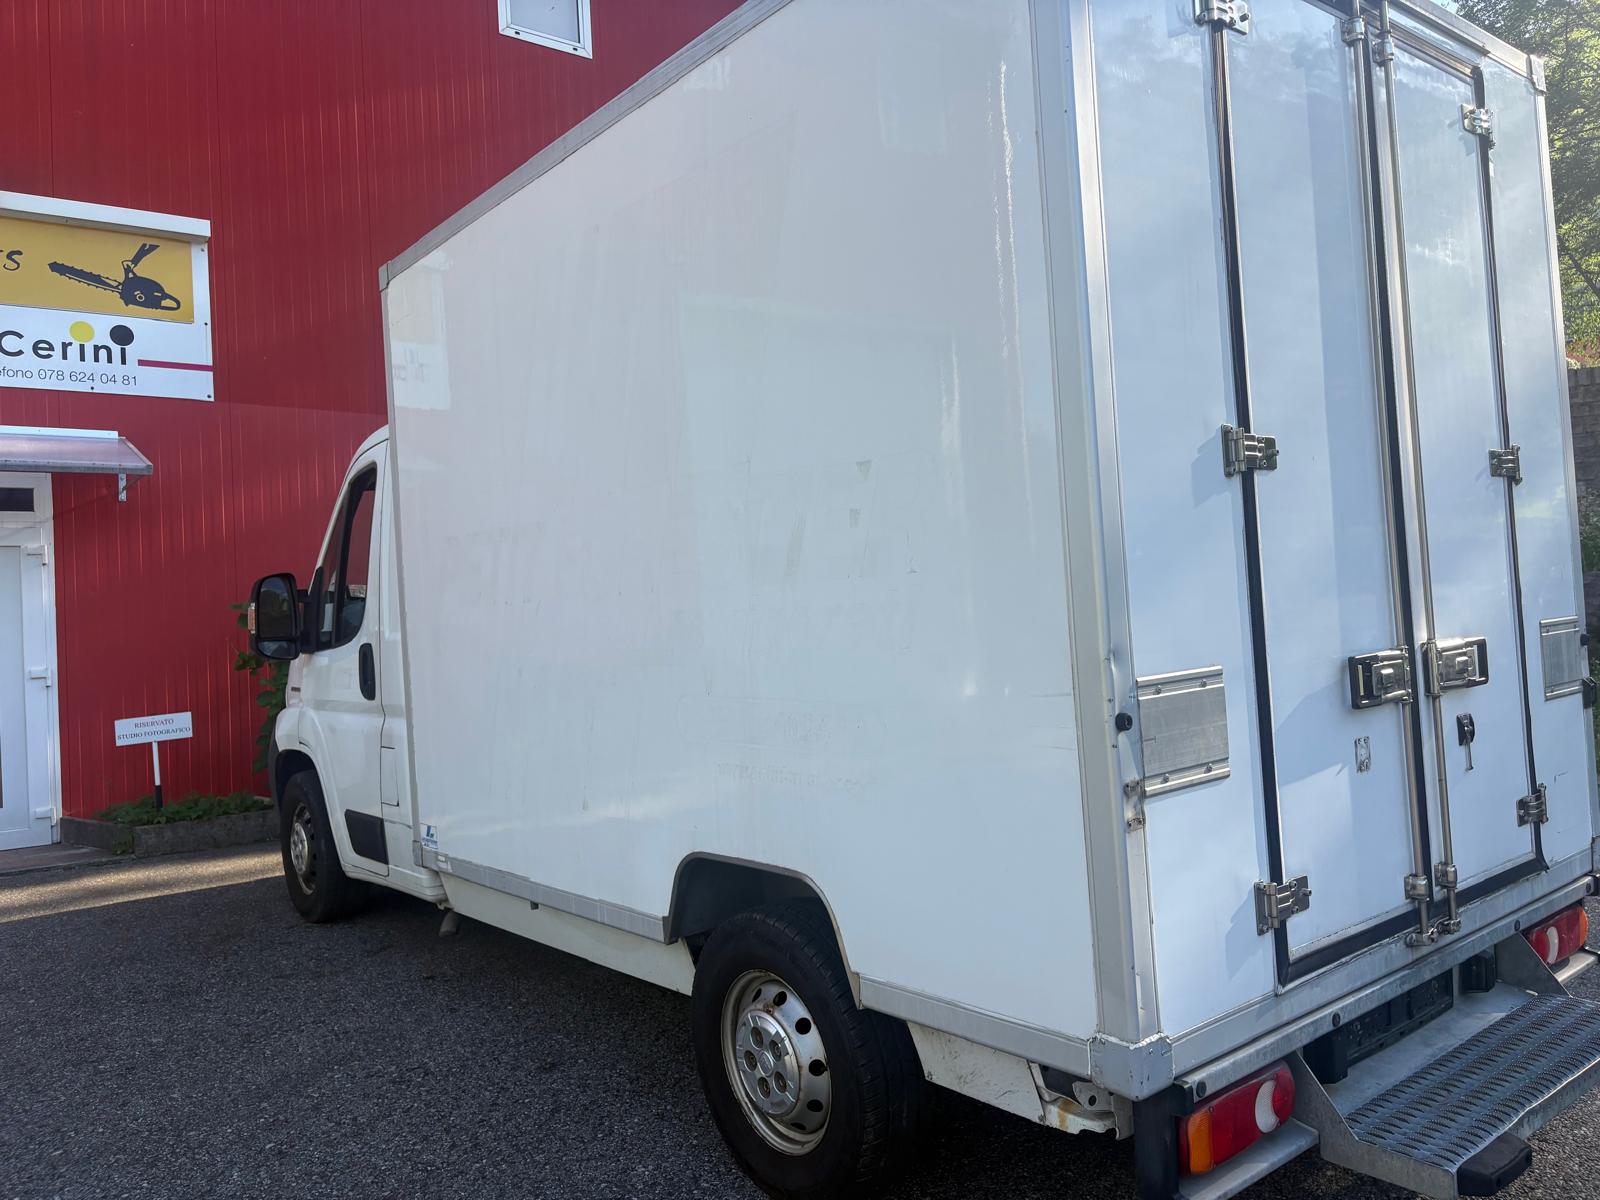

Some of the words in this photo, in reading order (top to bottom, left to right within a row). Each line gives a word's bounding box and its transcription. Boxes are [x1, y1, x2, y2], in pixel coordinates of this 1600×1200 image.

[0, 249, 23, 272] s
[0, 321, 135, 366] Cerini
[0, 366, 33, 379] fono
[38, 368, 65, 381] 078
[69, 371, 95, 383] 624
[100, 373, 117, 385] 04
[121, 374, 137, 386] 81
[134, 718, 174, 728] RISERVATO
[117, 732, 143, 740] STUDIO
[144, 727, 191, 737] FOTOGRAFICO
